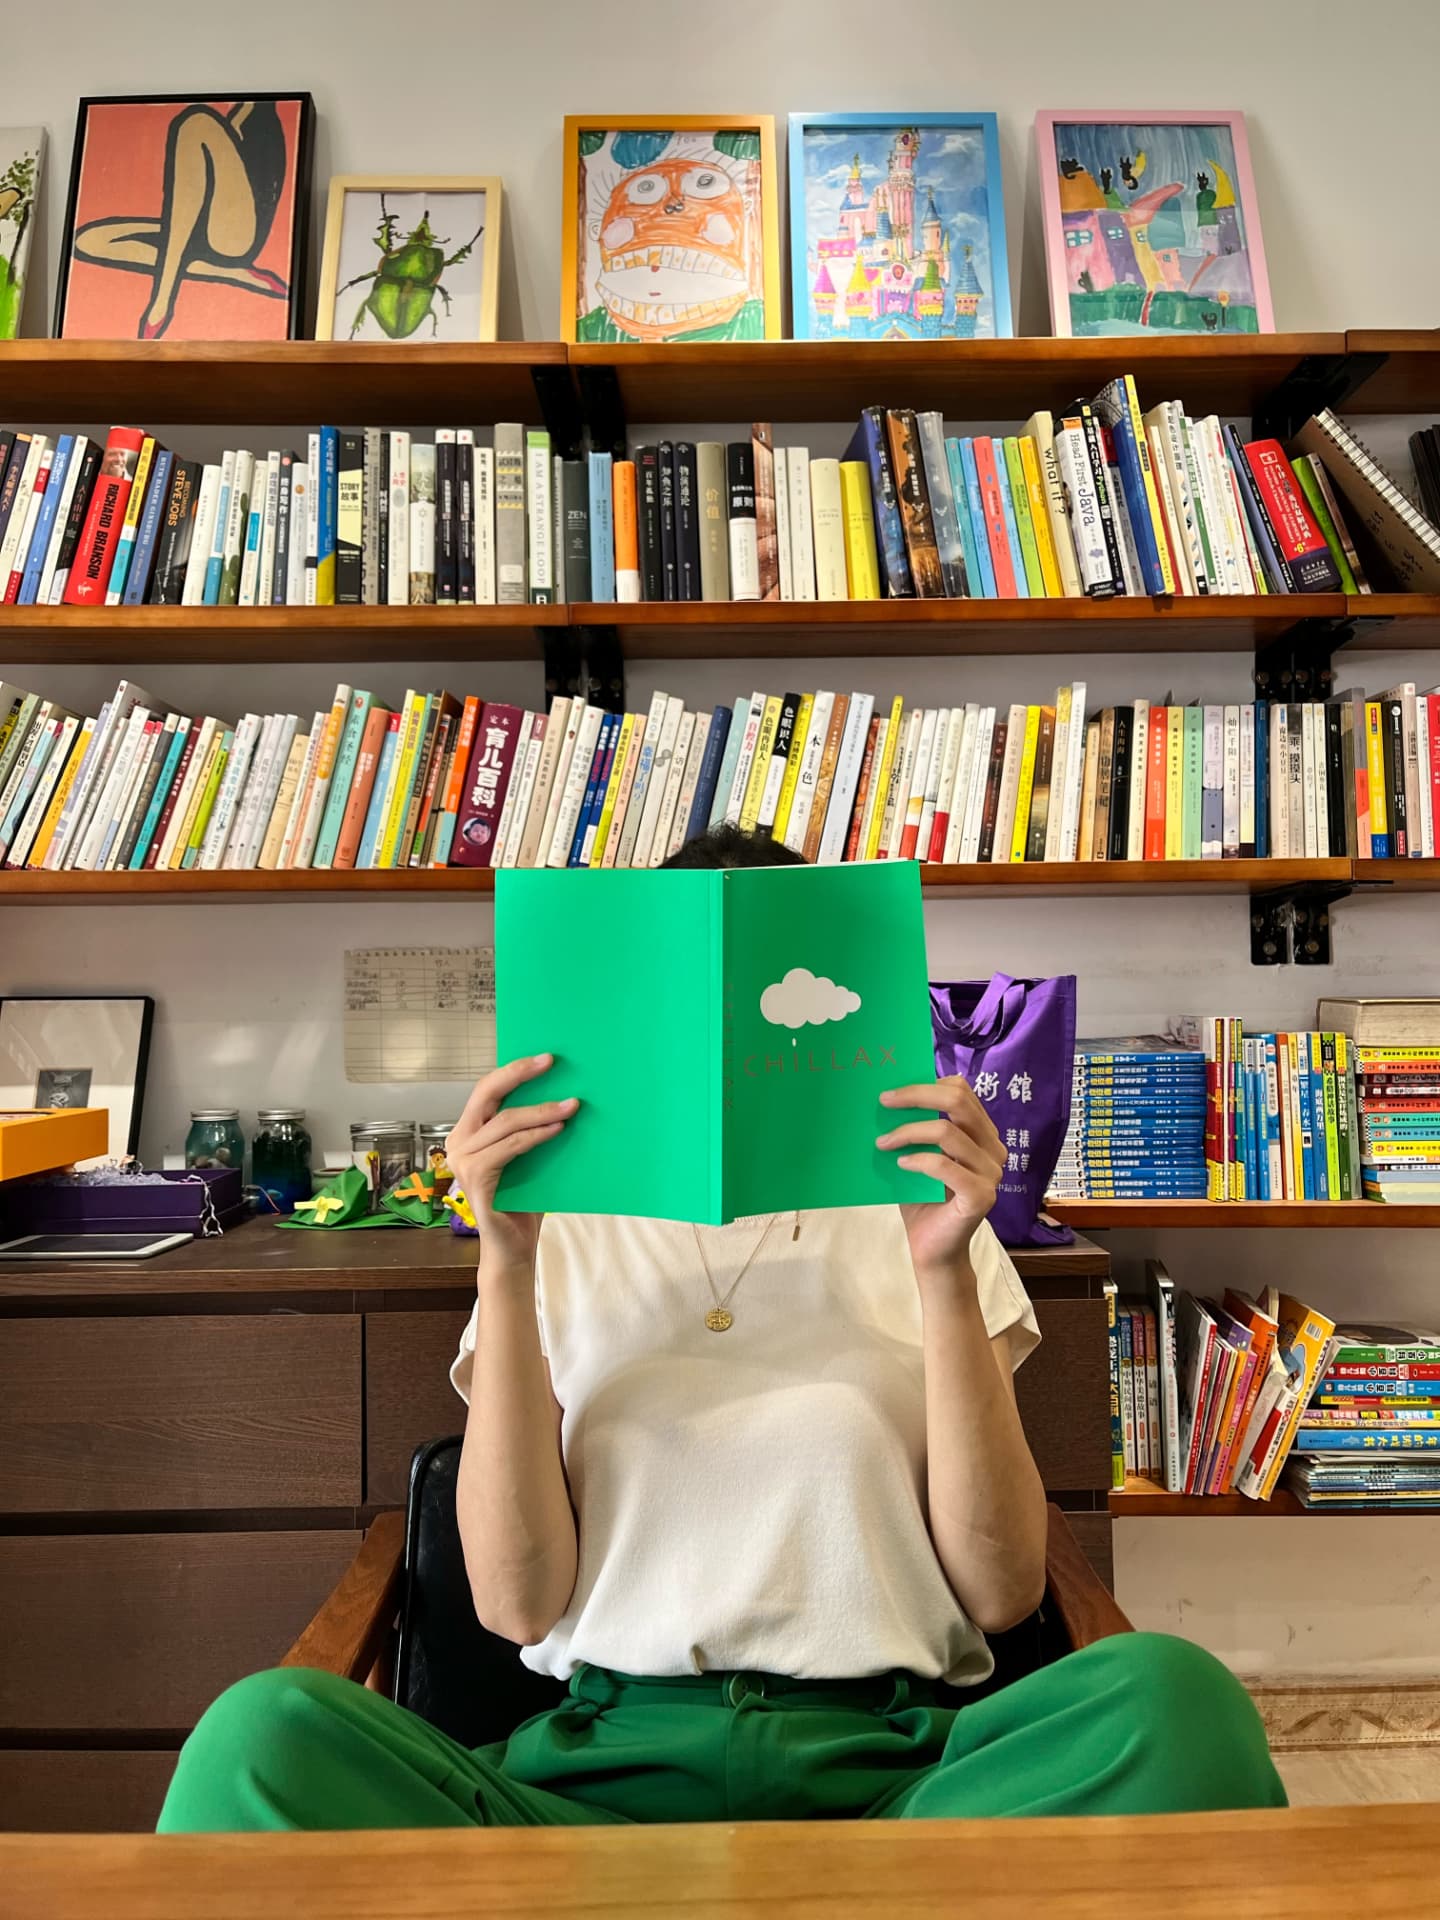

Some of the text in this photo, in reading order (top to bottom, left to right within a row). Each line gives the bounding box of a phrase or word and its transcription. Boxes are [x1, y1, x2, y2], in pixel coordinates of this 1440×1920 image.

[536, 461, 544, 478] AM
[1043, 447, 1060, 485] what
[1070, 434, 1095, 527] Head First Java
[151, 478, 162, 507] BADER
[172, 469, 187, 499] STEVE
[179, 480, 192, 518] BECOMING
[340, 482, 360, 491] STORY
[340, 492, 359, 501] 故事
[167, 498, 180, 527] JOBS
[568, 509, 587, 520] ZEN
[705, 488, 721, 520] 价值
[732, 497, 754, 508] 原则
[86, 483, 119, 580] RICHARD BRANSON
[536, 494, 545, 548] STRANGE
[537, 553, 547, 584] LOOP
[489, 714, 511, 726] 定本
[775, 707, 795, 752] 色眼识人
[471, 727, 509, 809] 育儿百科
[743, 1045, 897, 1078] CHILLAX
[1123, 1370, 1133, 1419] 中外民间故事
[1135, 1368, 1145, 1419] 中华美德故事
